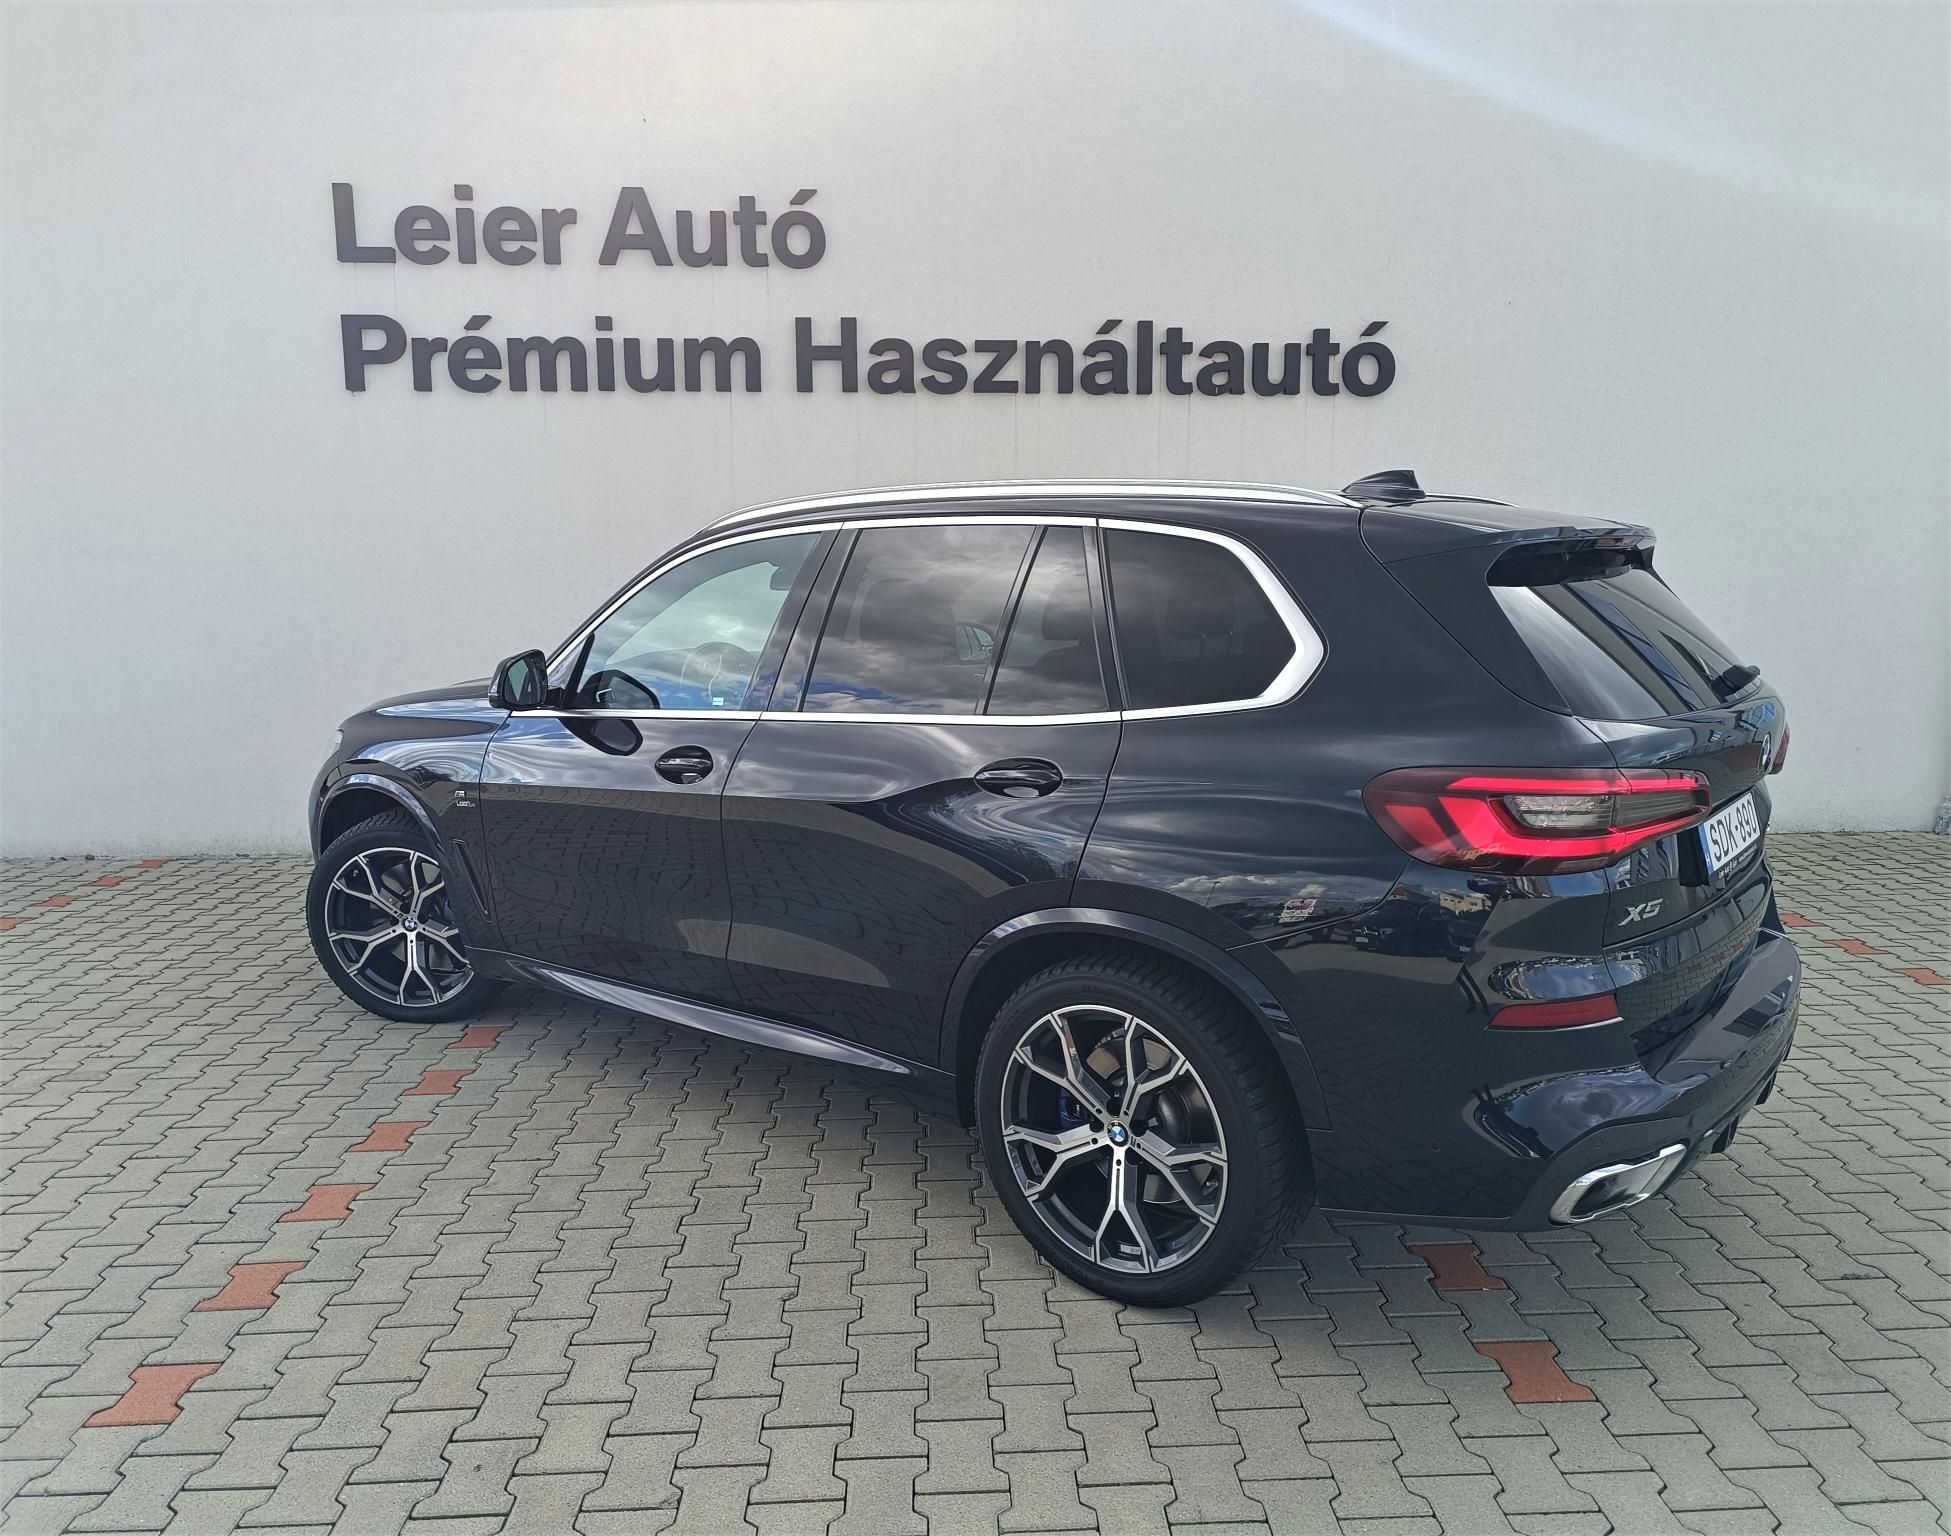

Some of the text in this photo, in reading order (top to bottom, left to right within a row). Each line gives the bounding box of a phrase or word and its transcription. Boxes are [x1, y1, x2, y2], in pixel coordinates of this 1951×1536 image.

[331, 182, 827, 270] Leier Autó
[340, 313, 1397, 399] Prémium Használtautó
[1709, 799, 1757, 862] SDK-890
[1618, 898, 1664, 926] X5
